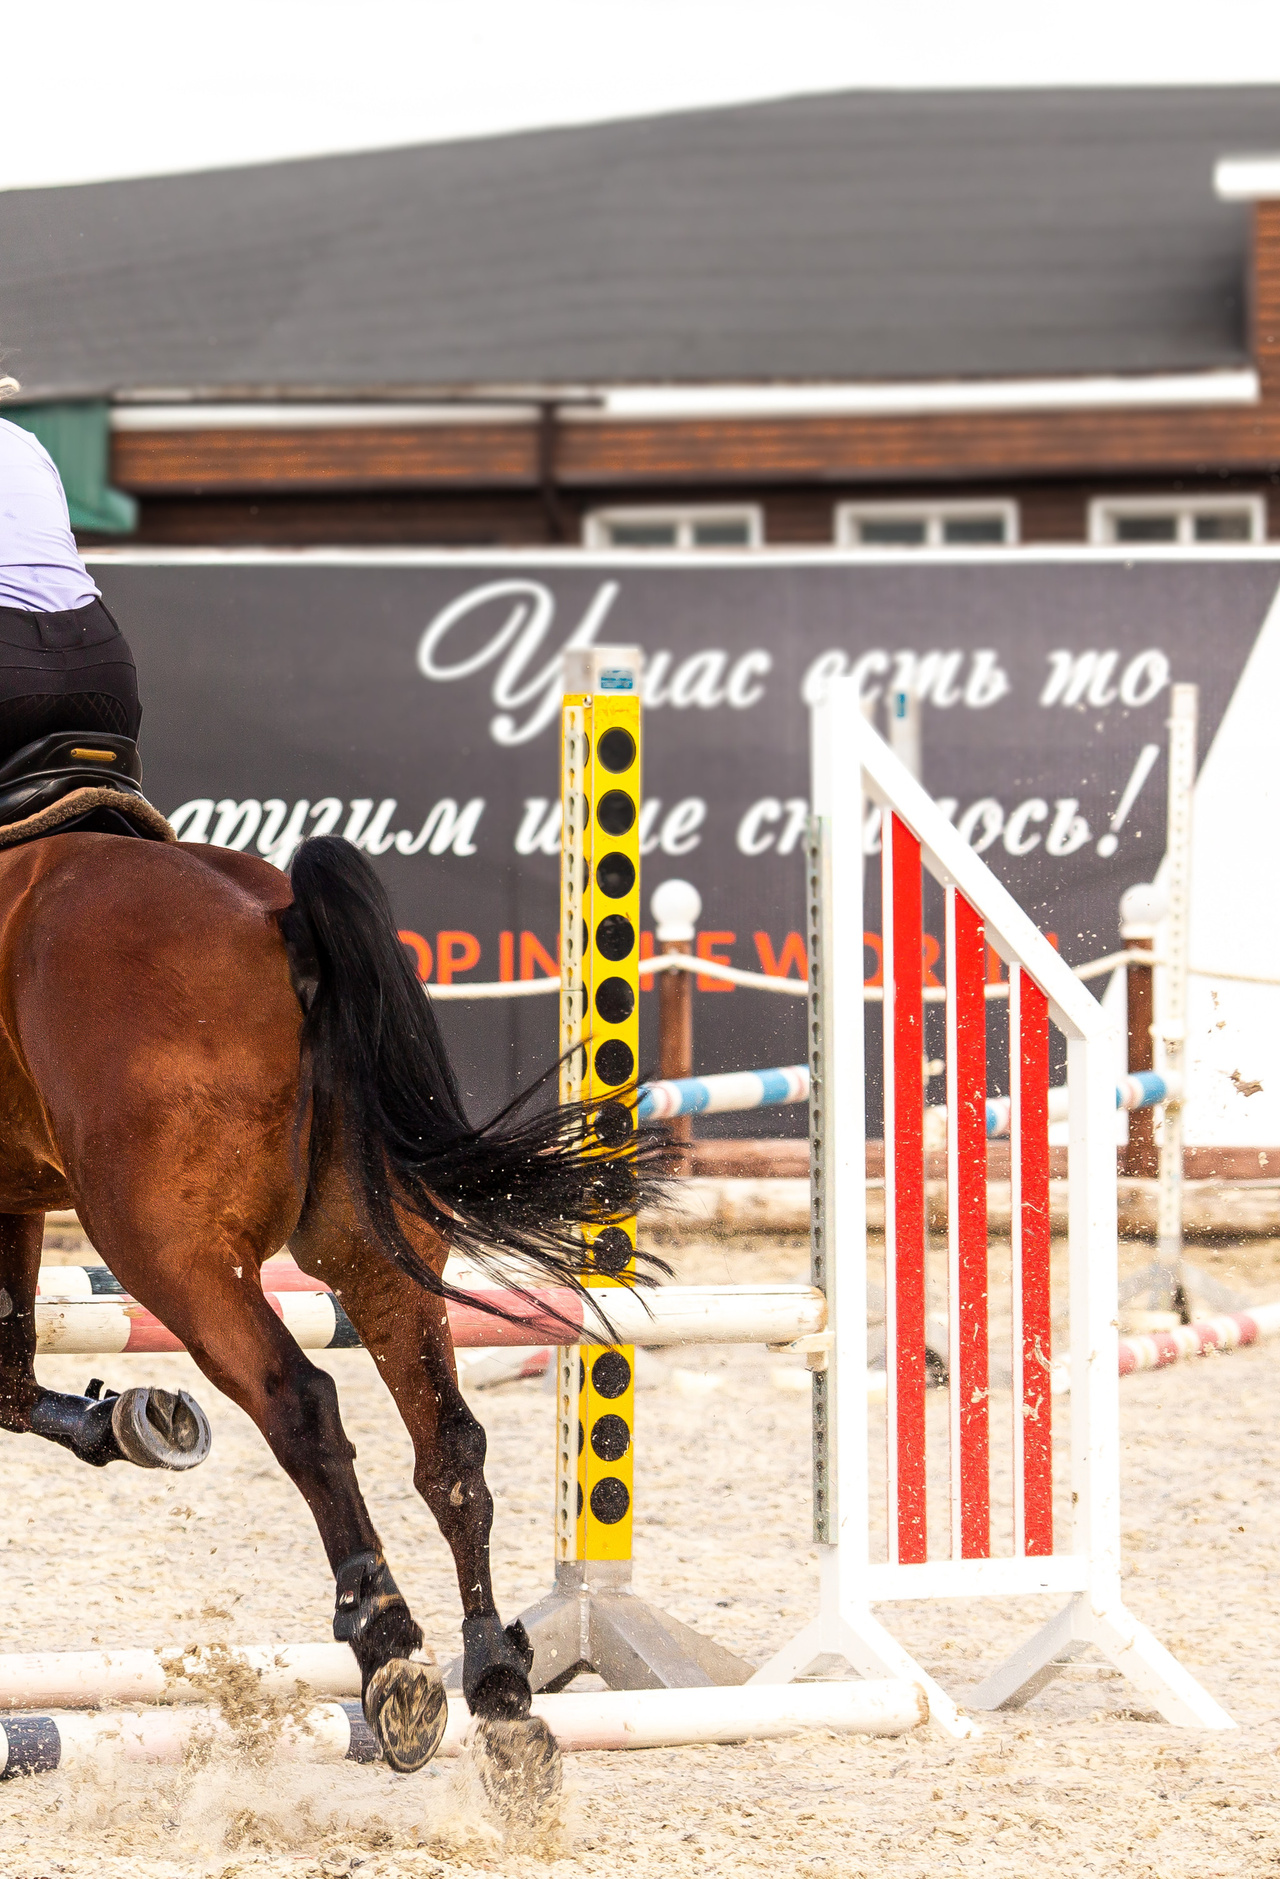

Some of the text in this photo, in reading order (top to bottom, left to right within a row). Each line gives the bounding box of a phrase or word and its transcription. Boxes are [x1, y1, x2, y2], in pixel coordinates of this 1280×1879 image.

[416, 577, 619, 747] У
[802, 648, 1010, 709] есть
[1039, 648, 1171, 709] то
